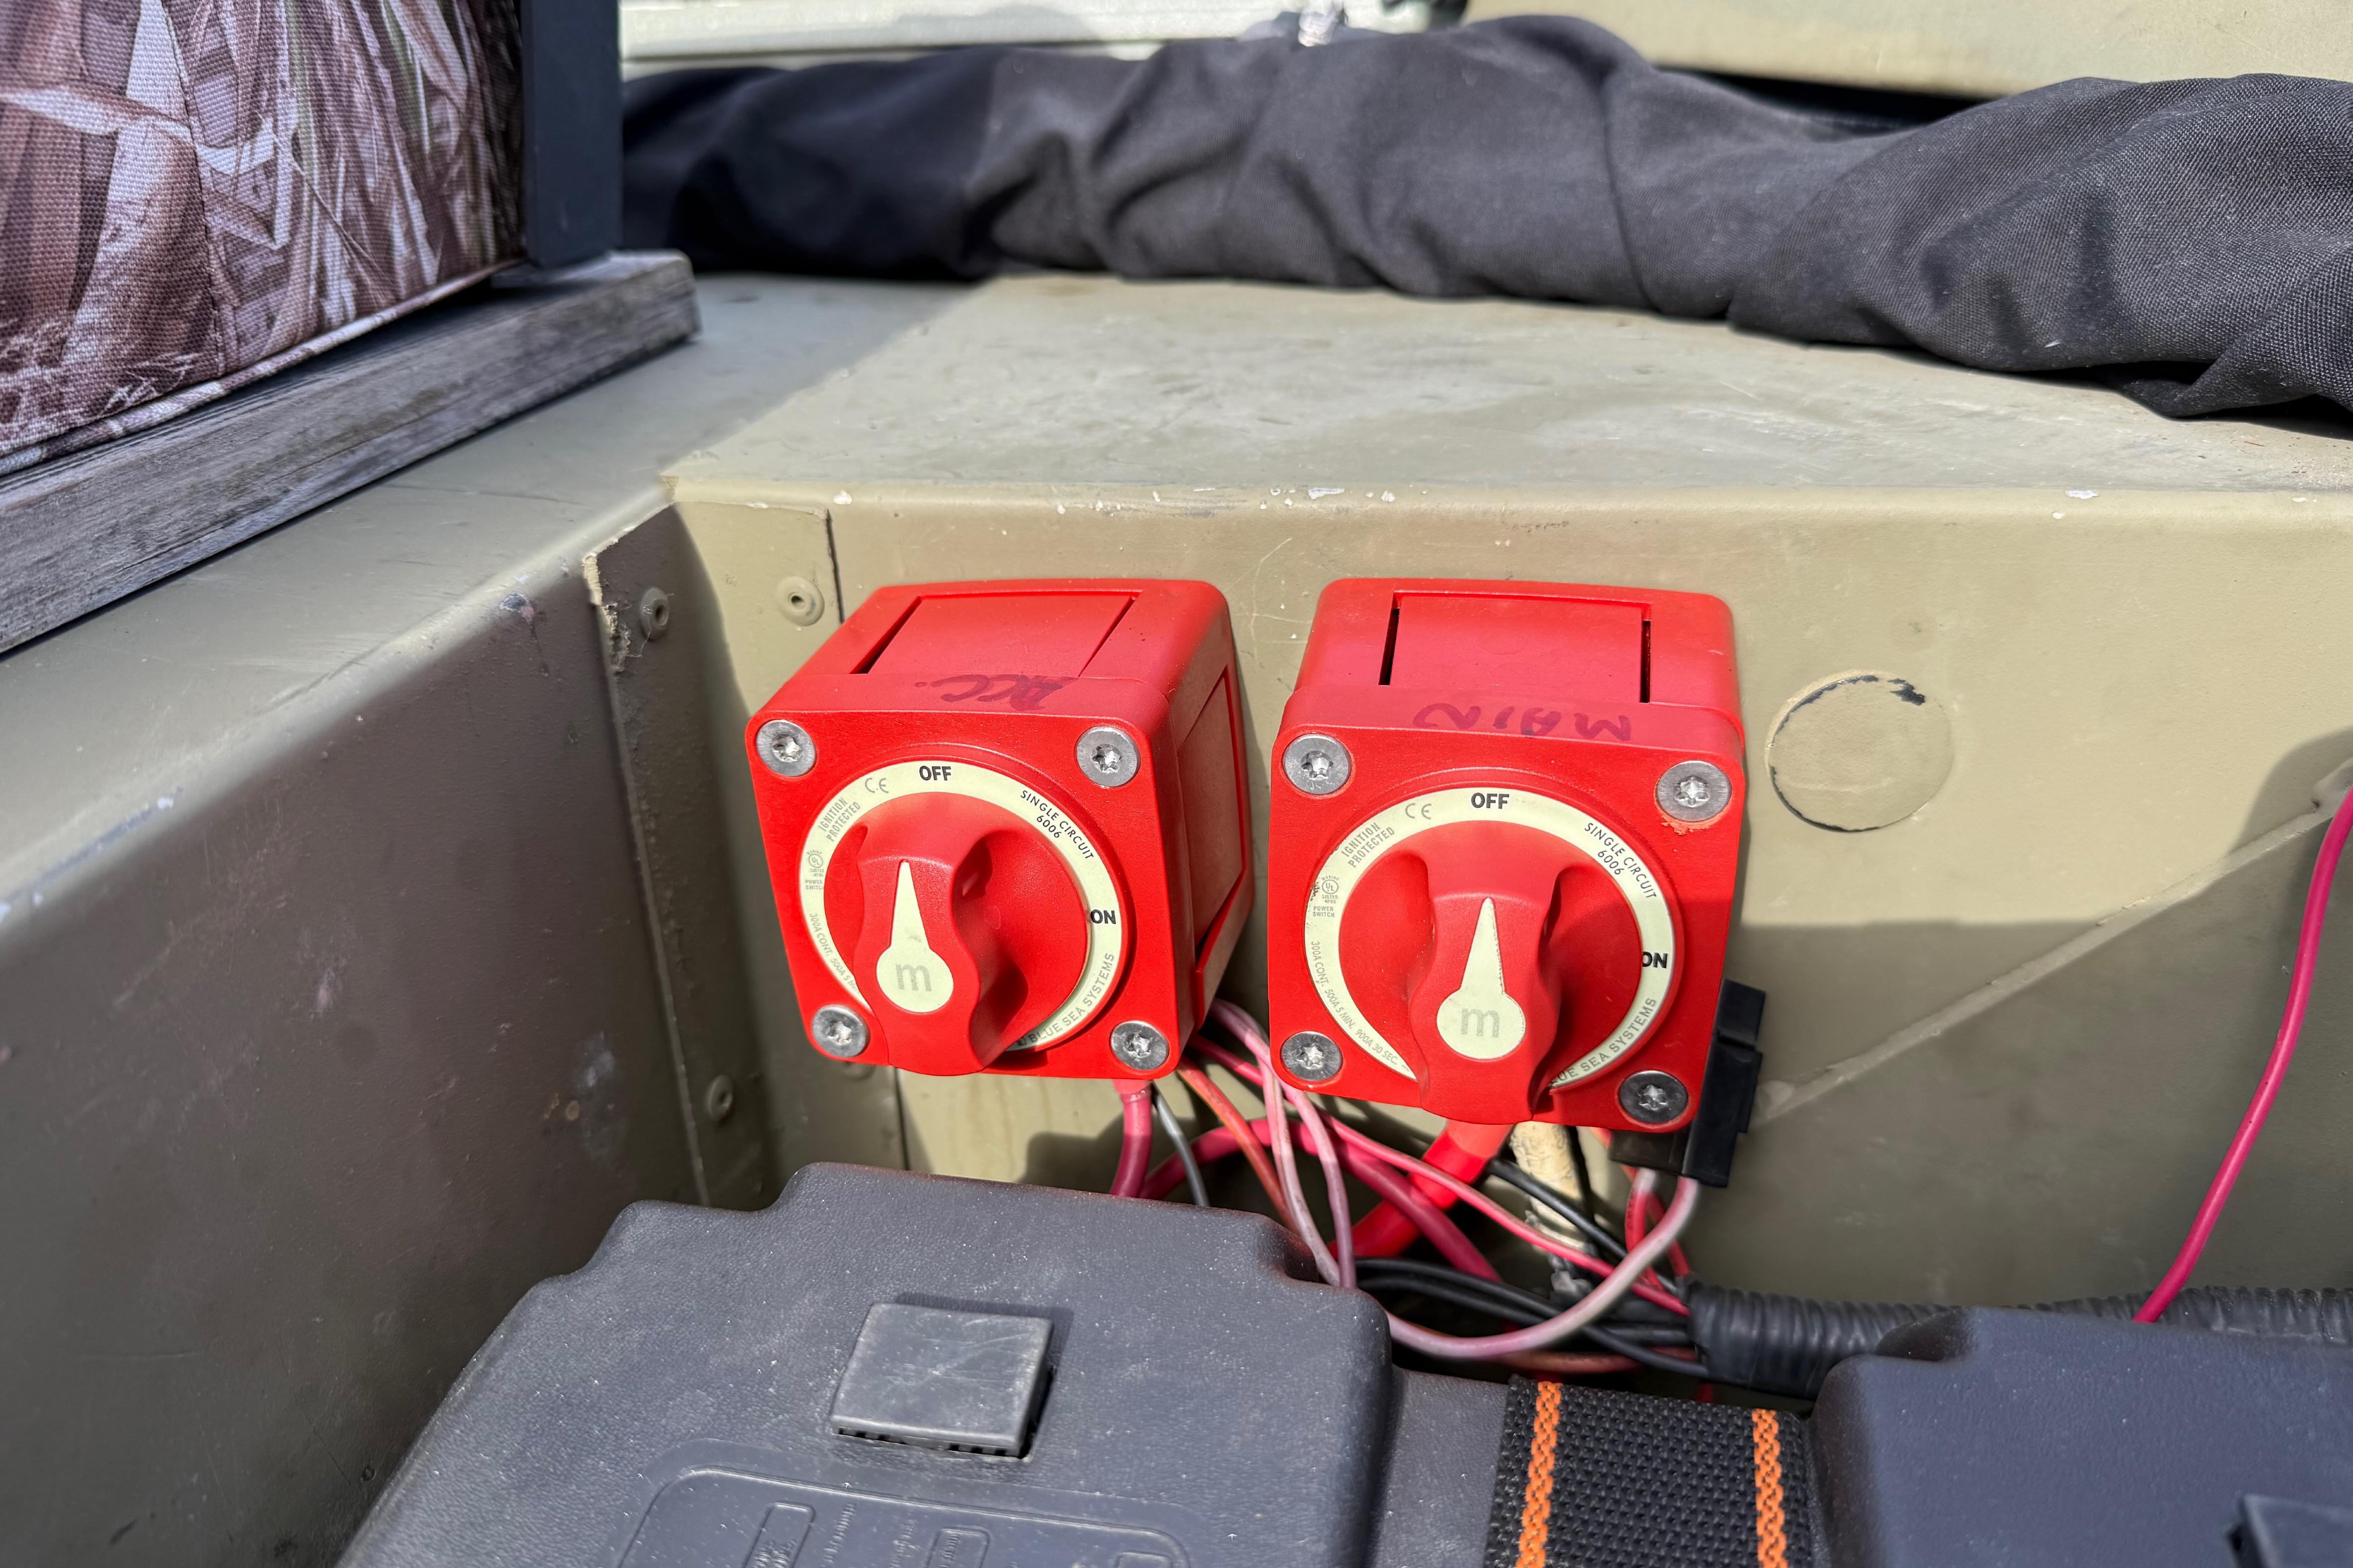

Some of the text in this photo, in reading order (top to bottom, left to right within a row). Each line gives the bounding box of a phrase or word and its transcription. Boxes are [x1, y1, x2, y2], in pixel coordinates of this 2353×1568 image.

[920, 766, 951, 781] OFF
[1471, 792, 1510, 809] OFF
[818, 797, 848, 832] IGNITION
[826, 801, 861, 842] PROTECTED
[1020, 790, 1094, 859] SINGLE CIRCUIT
[1036, 815, 1062, 838] 6006
[1341, 822, 1381, 857] IGNITION
[1348, 826, 1395, 868] PROTECTED
[1584, 822, 1657, 898] SINGLE CIRCUIT
[1598, 850, 1625, 875] 6006
[1090, 909, 1117, 925] ON
[810, 913, 822, 933] 300A
[817, 932, 833, 956] CONT.
[830, 958, 846, 977] 500A
[1311, 941, 1320, 961] 300A
[1642, 951, 1668, 969] ON
[1315, 961, 1329, 986] CONT.
[1028, 953, 1115, 1043] BLUE SEA SYSTEMS
[1325, 988, 1339, 1008] 500A
[1339, 1011, 1355, 1029] MIN.
[1355, 1029, 1373, 1047] 900A
[1580, 1052, 1610, 1072] SEA
[1609, 997, 1656, 1053] SYSTEMS
[1372, 1043, 1383, 1054] 30
[1382, 1050, 1399, 1065] SEC.
